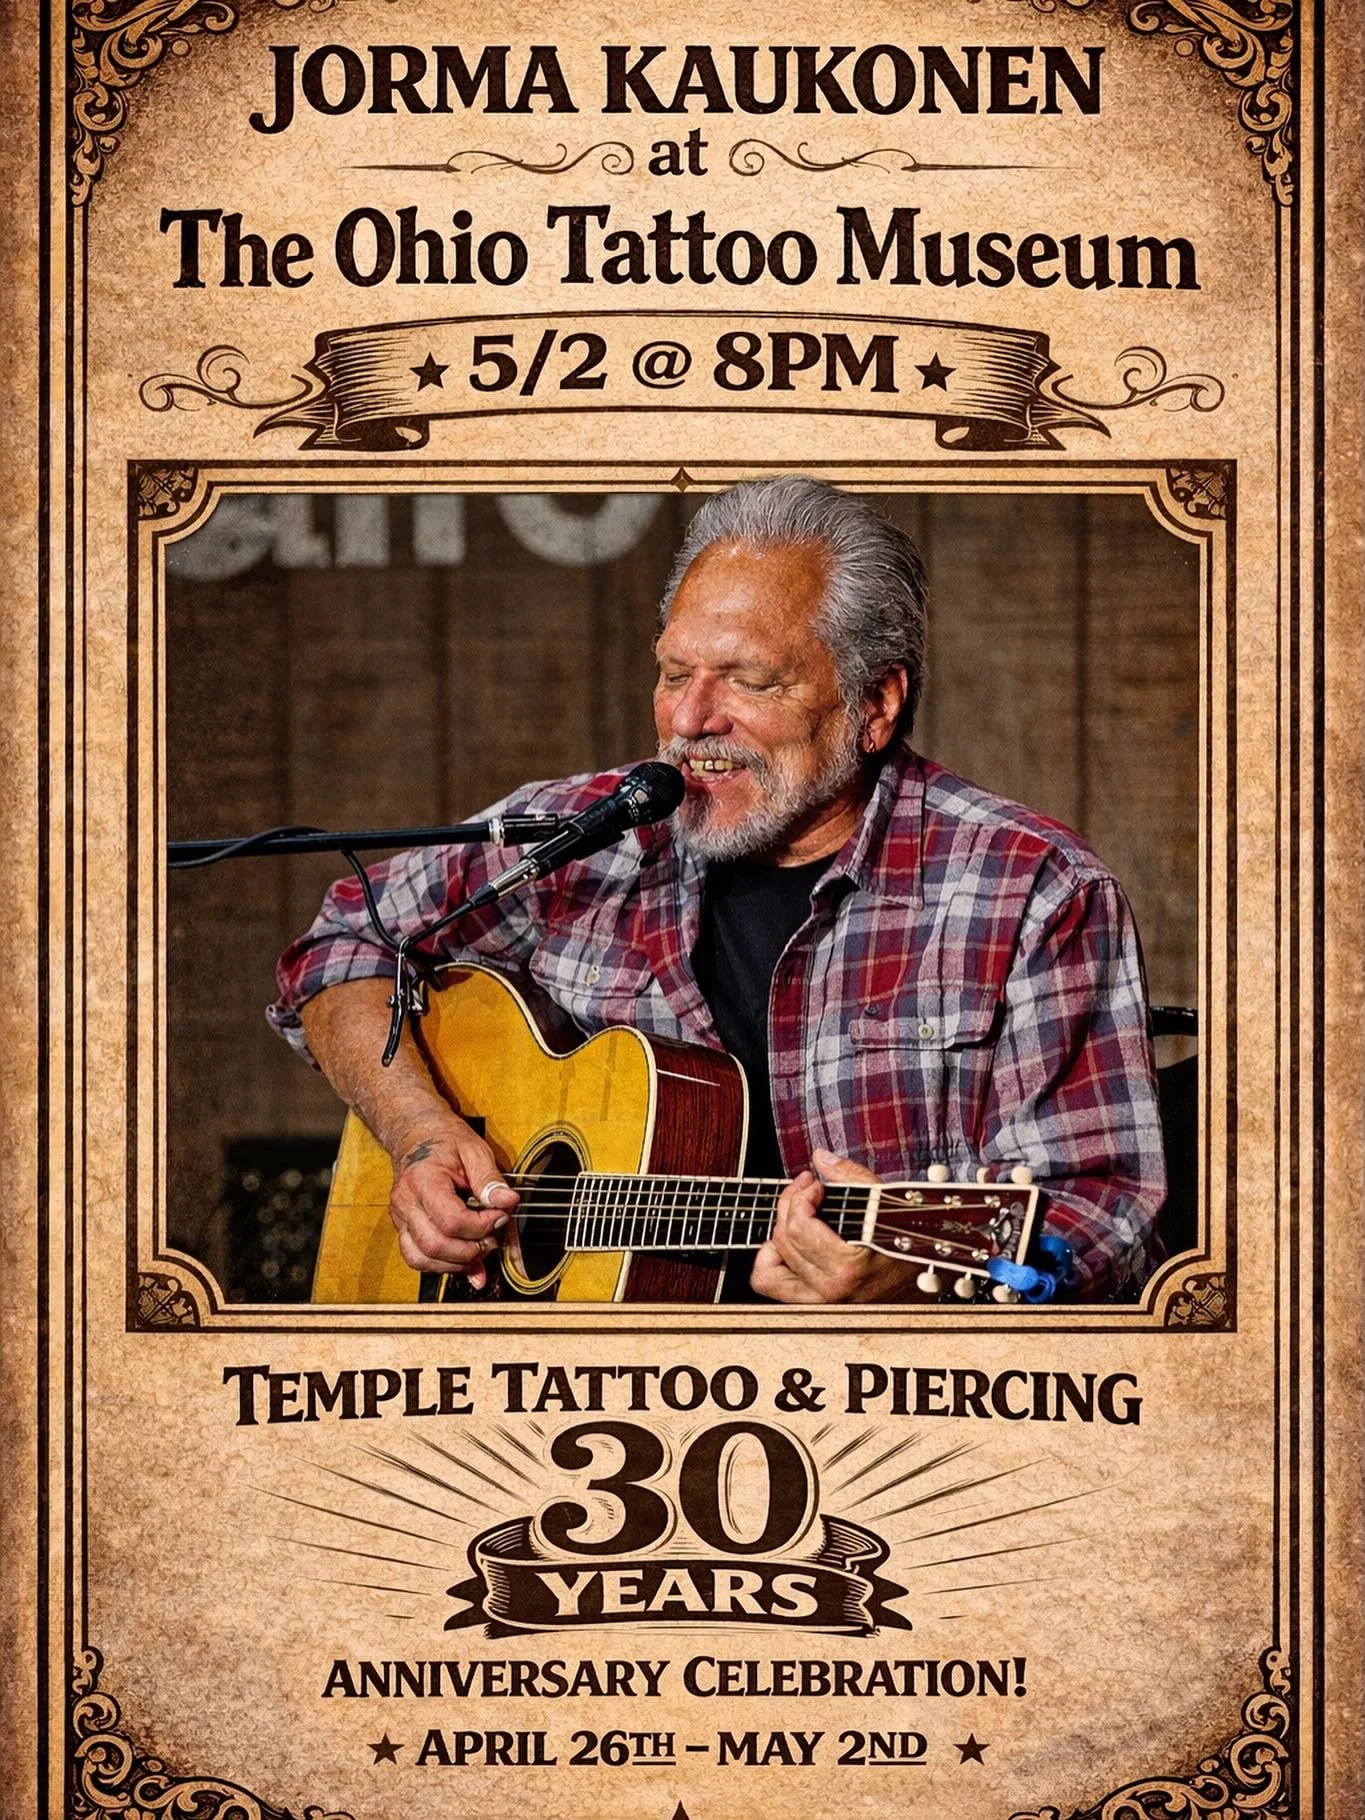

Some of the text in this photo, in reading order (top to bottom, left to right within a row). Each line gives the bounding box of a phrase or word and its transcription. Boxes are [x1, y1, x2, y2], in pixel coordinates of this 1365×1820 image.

[248, 44, 1106, 135] JORMA KAUKONEN
[648, 127, 709, 177] at
[159, 204, 1202, 291] The Ohio Tattoo Museum
[469, 329, 900, 396] 5/2 @ 8PM
[222, 1362, 1143, 1426] TEMPLE TATTOO & PIERCING
[539, 1420, 811, 1556] 30
[534, 1567, 819, 1618] YEARS
[321, 1655, 1027, 1699] ANNIVERSARY CELEBRATION!
[414, 1729, 558, 1766] APRIL
[569, 1729, 677, 1767] 26TH
[717, 1731, 826, 1766] MAY
[837, 1730, 928, 1766] 2ND
